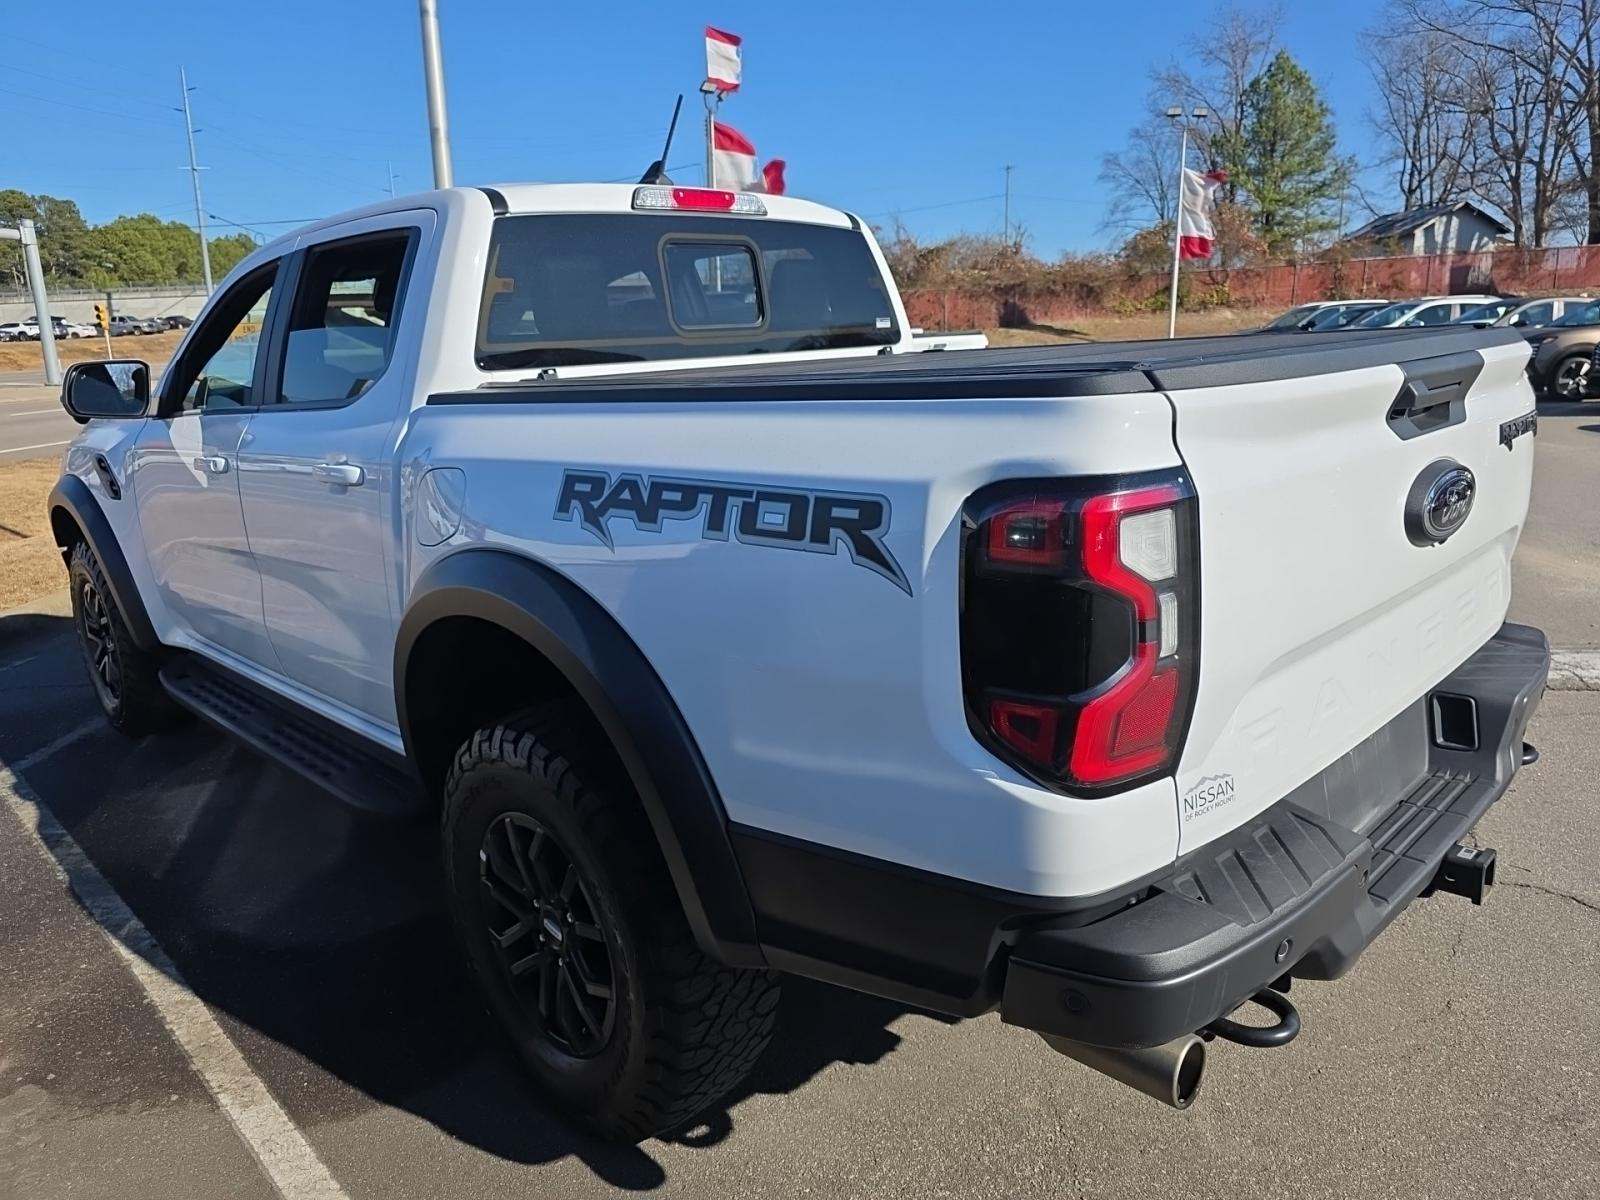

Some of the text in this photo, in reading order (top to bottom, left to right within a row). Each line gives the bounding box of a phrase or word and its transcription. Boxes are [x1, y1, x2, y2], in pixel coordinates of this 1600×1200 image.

[553, 468, 913, 598] RAPTOR
[1183, 777, 1235, 814] NISSAN
[1185, 812, 1195, 822] OF
[1194, 804, 1214, 819] ROCKY
